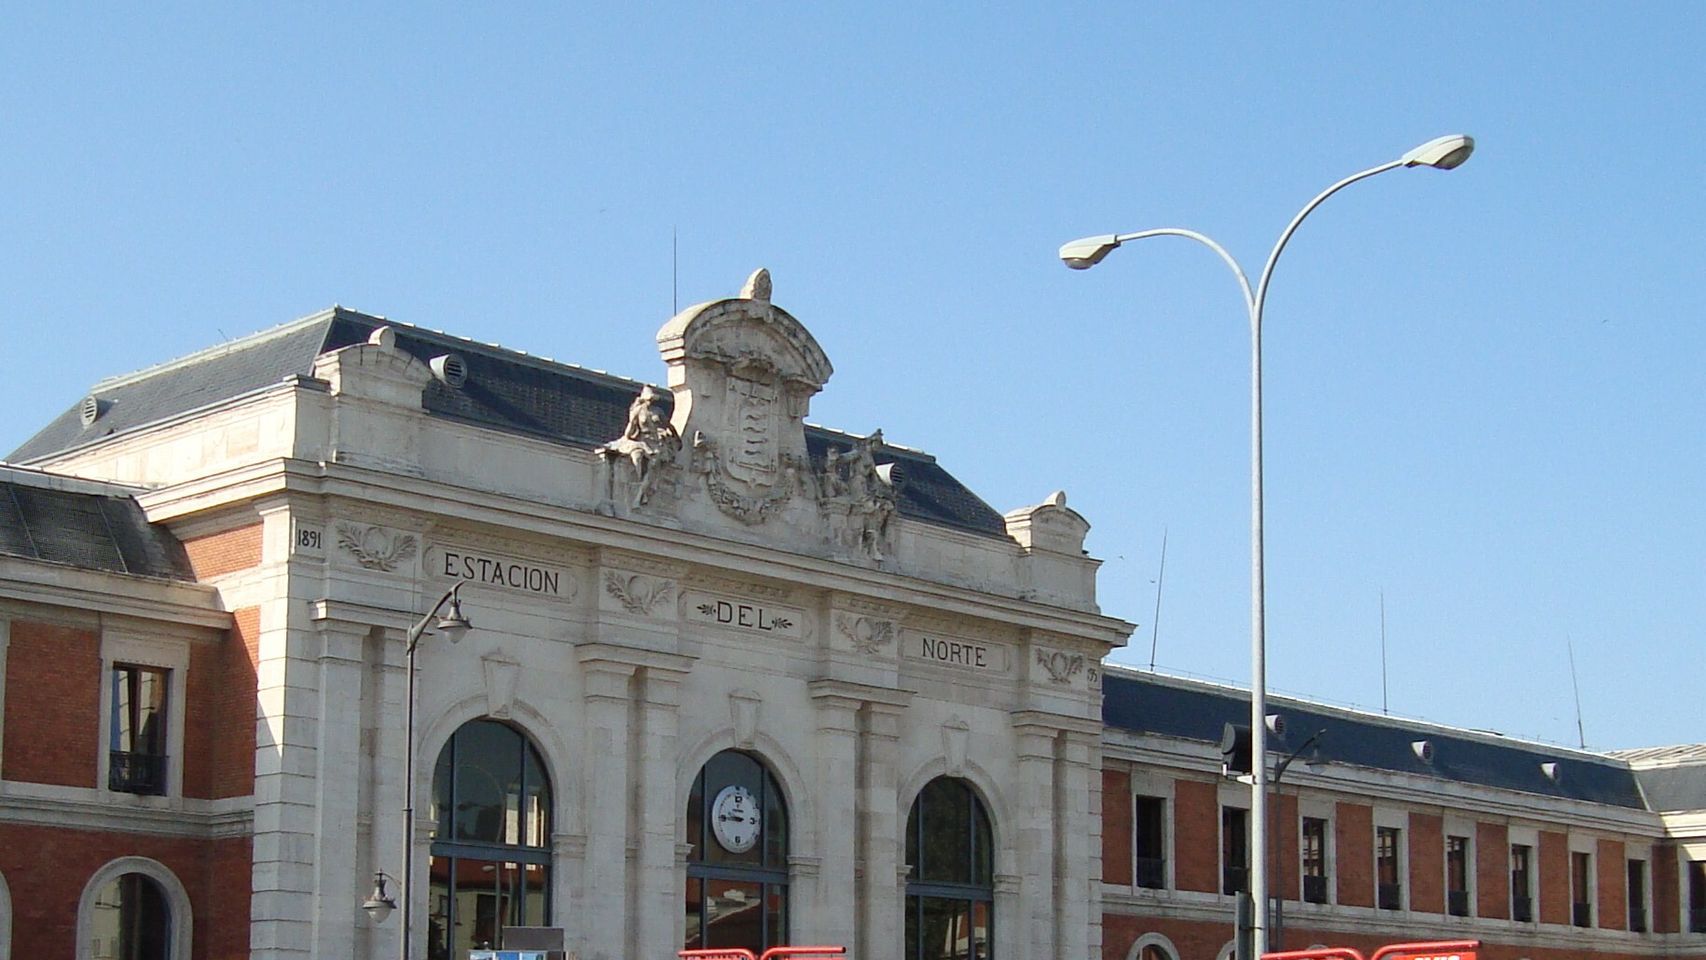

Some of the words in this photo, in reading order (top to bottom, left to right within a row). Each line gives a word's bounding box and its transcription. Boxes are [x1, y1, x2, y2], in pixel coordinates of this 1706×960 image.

[297, 529, 321, 549] 1891
[444, 552, 559, 594] ESTACION
[717, 600, 772, 631] DEL
[922, 637, 987, 668] NORTE
